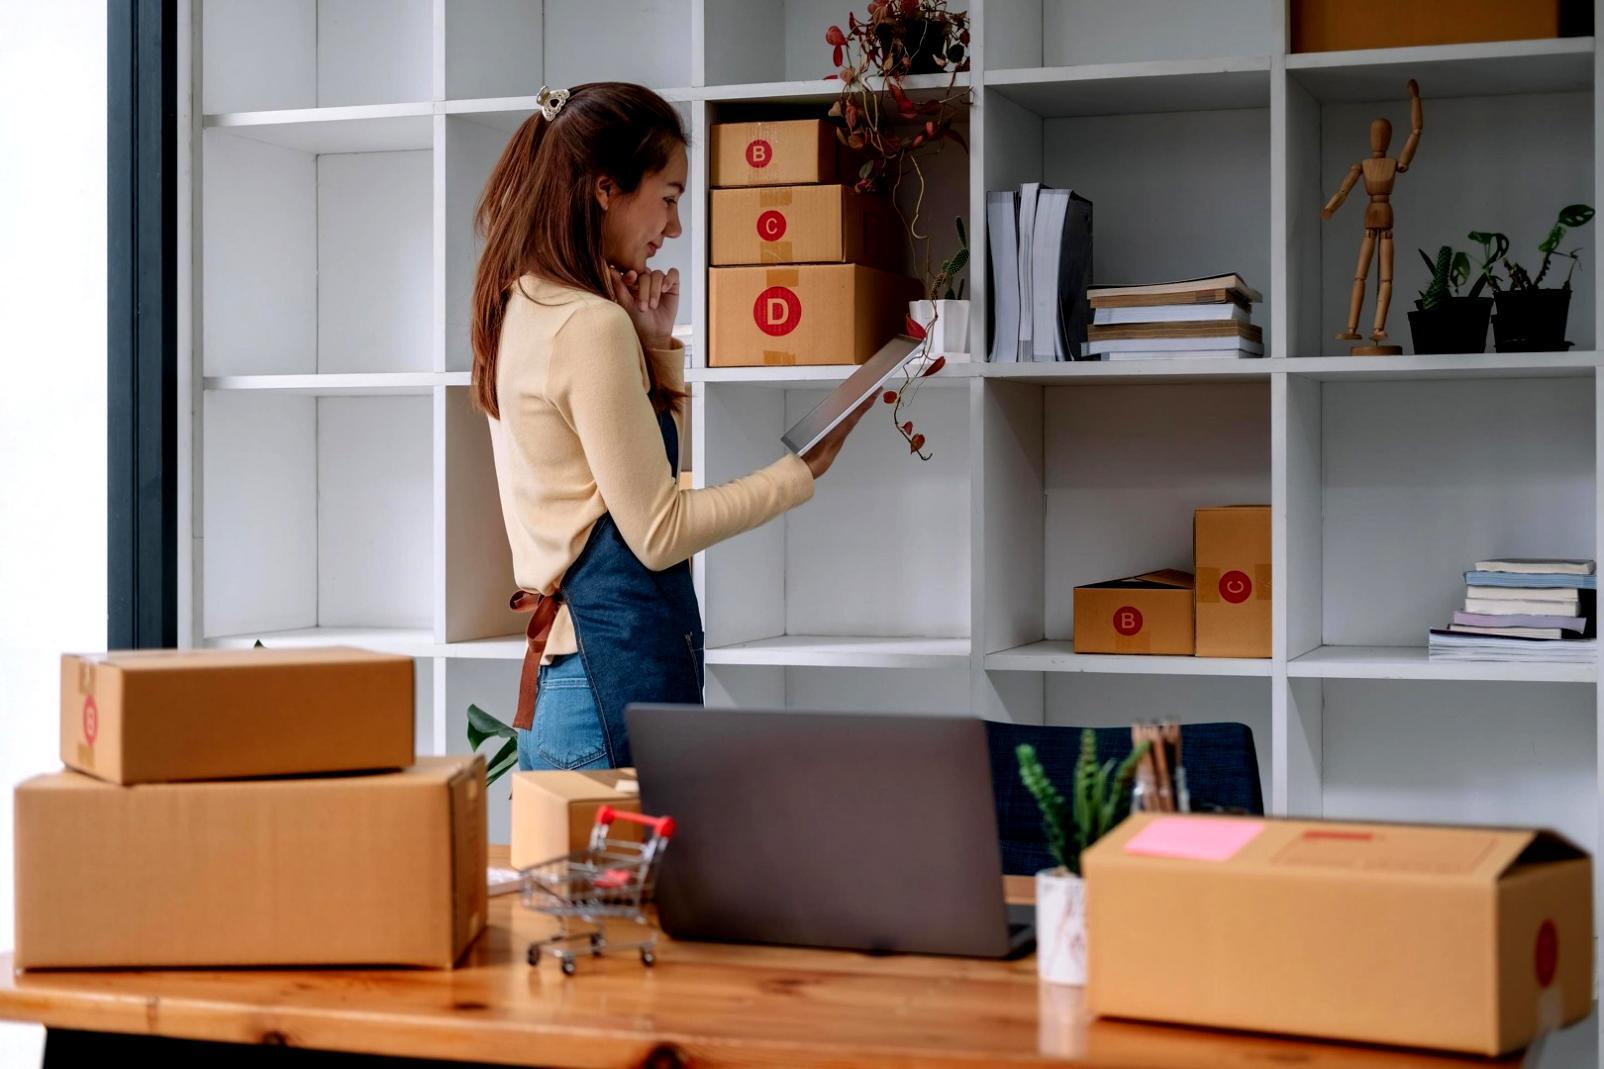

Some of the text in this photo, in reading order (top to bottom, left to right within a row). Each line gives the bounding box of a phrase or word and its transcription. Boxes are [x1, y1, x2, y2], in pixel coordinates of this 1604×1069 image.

[753, 146, 765, 161] B
[766, 218, 778, 234] C
[767, 298, 789, 325] D
[1227, 581, 1244, 593] C
[1121, 613, 1135, 628] B
